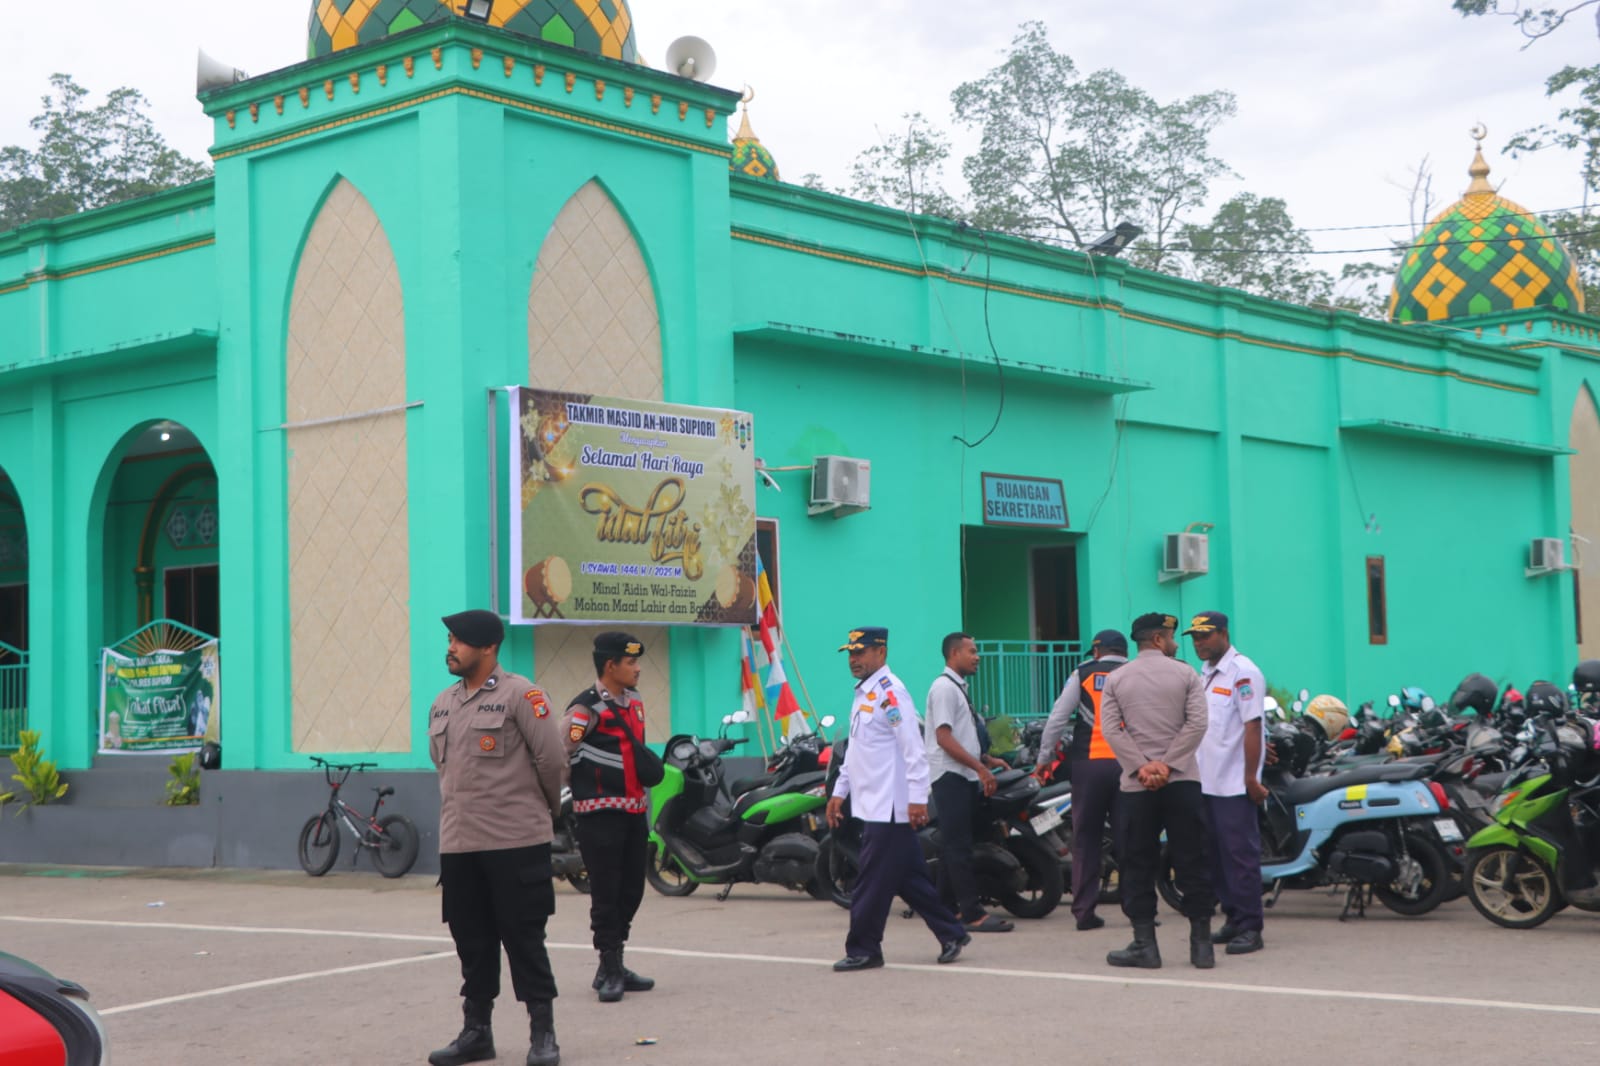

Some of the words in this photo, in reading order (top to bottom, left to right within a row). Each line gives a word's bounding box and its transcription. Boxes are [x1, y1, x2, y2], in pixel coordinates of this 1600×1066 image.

[567, 405, 604, 424] TAKMIR
[607, 410, 641, 429] MASJID
[643, 414, 677, 433] AN-NUR
[680, 418, 716, 437] SUPIORI
[582, 446, 637, 467] Selamat
[641, 453, 669, 471] Hari
[672, 456, 704, 479] Raya
[996, 482, 1050, 501] RUANGAN
[987, 500, 1062, 520] SEKRETARIAT
[588, 564, 617, 575] SYAWAL
[621, 565, 638, 575] 1446
[641, 566, 646, 575] H
[655, 567, 673, 577] 2025
[674, 568, 682, 577] M
[592, 582, 620, 596] Minal
[650, 584, 697, 598] Wal-Faizin
[574, 598, 610, 612] Mohon
[612, 599, 638, 613] Maaf
[641, 600, 666, 613] Lahir
[669, 601, 687, 614] dan
[477, 704, 505, 713] POLRI
